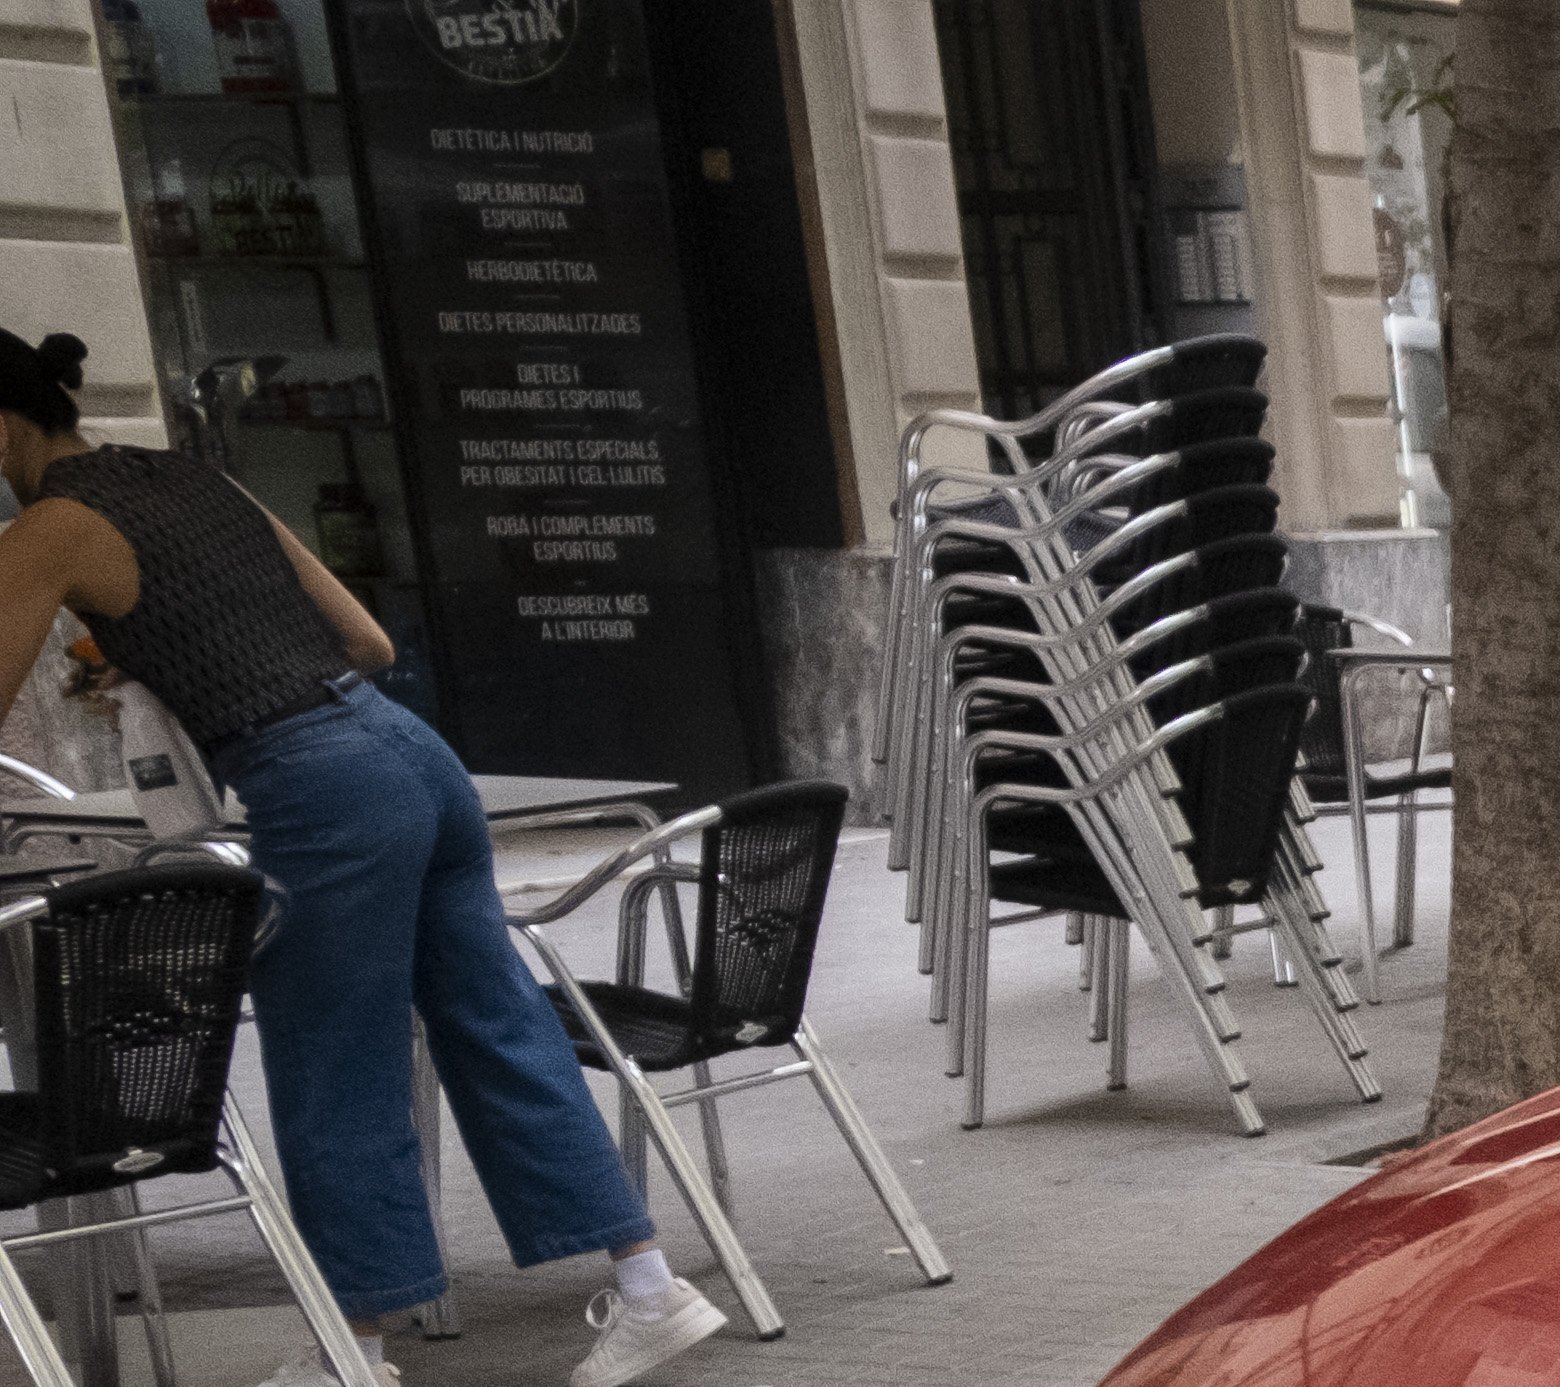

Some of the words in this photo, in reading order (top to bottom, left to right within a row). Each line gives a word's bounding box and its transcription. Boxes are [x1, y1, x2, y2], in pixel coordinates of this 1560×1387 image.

[456, 181, 585, 204] SUPLEMENTACIÓ
[480, 209, 568, 230] ESPORTIVA
[438, 312, 493, 332] DIETES
[496, 312, 641, 334] PERSONALITZADES
[517, 363, 571, 384] DIETES
[460, 389, 556, 409] PROGRAMES
[559, 389, 643, 410] ESPORTIUS
[459, 440, 575, 460] TRACTAMENTS
[576, 440, 659, 461] ESPECIALS
[460, 465, 491, 486] PER
[494, 465, 565, 486] OBESITAT
[486, 514, 530, 536] ROBA
[540, 515, 655, 536] COMPLEMENTS
[533, 541, 617, 561] ESPORTIUS
[517, 595, 612, 616] DESCUBREIX
[541, 621, 553, 640] A
[555, 620, 636, 641] L'INTERIOR
